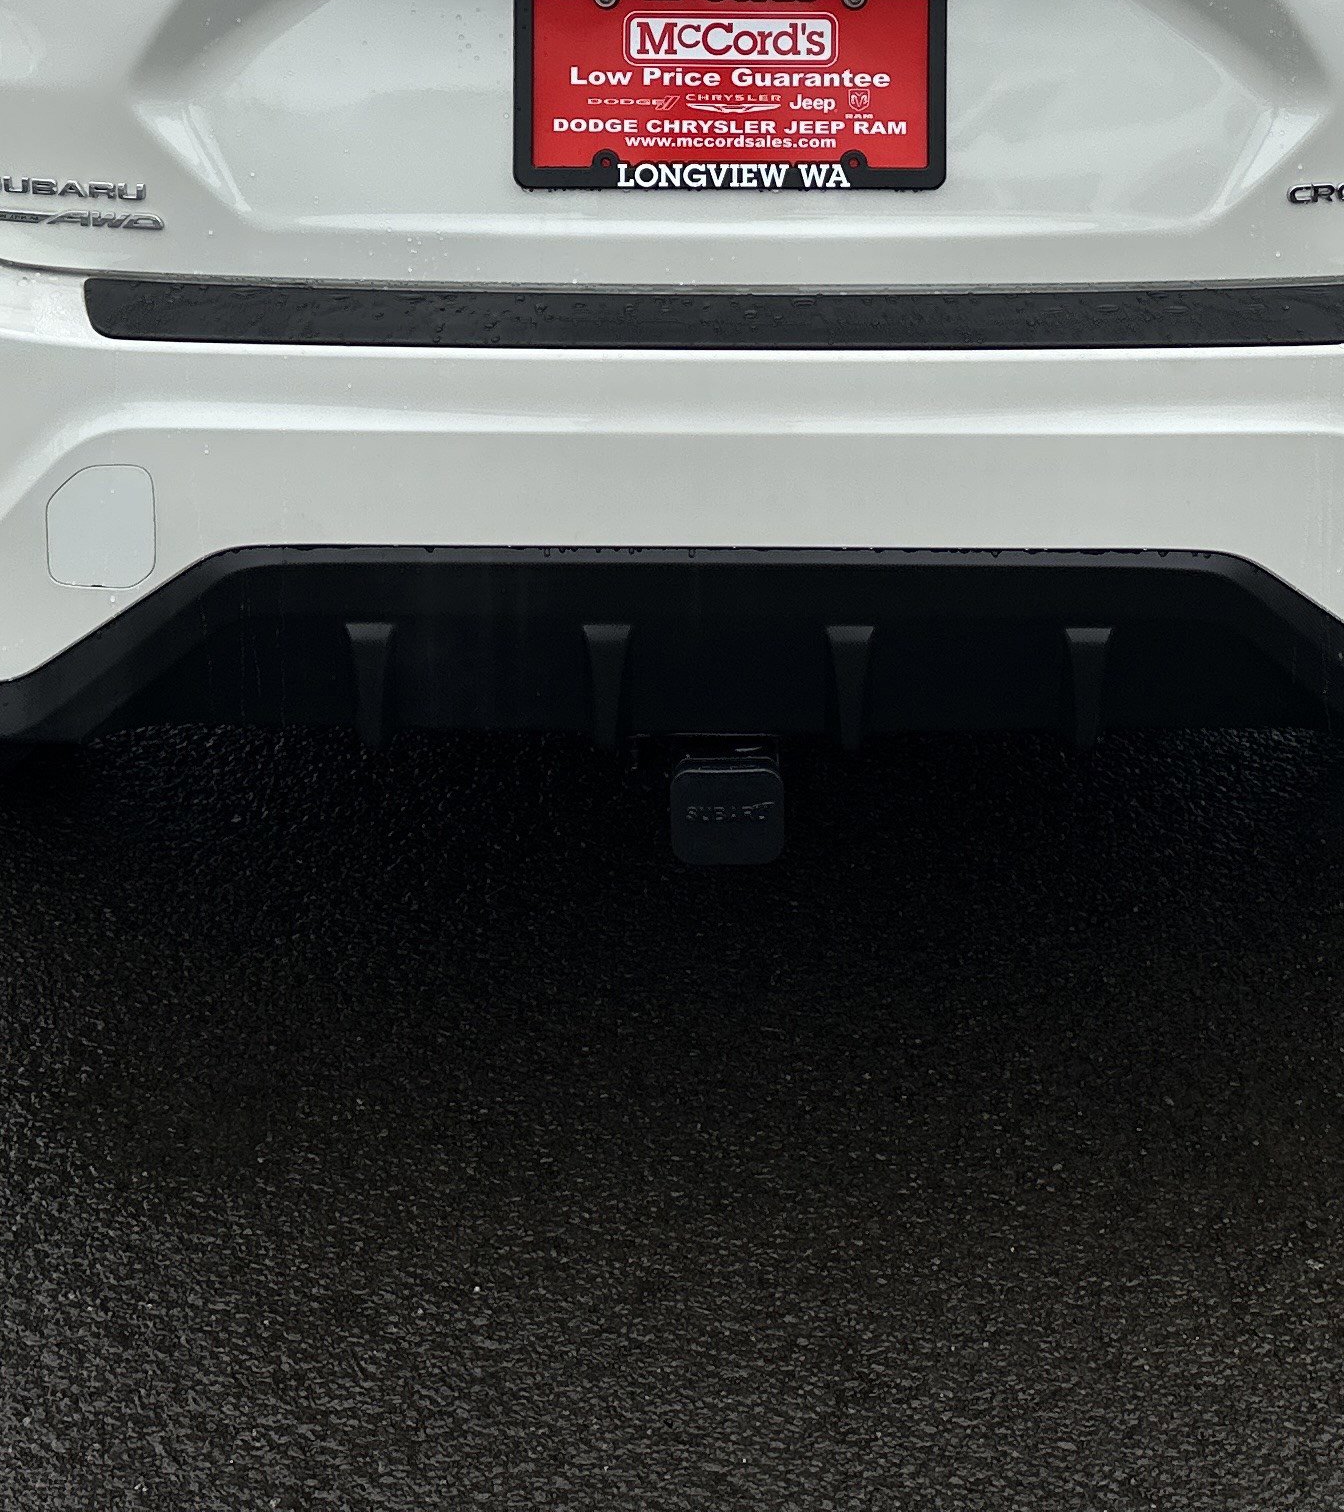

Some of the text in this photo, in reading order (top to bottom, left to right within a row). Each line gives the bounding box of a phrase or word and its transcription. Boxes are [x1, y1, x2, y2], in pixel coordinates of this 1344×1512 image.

[636, 21, 826, 56] McCord's
[569, 66, 891, 88] Low Price Guarantee
[587, 93, 837, 113] DODGE CHRYSLER Jeep
[553, 119, 907, 135] DODGE CHRYSLER JEEP RAM
[624, 134, 837, 148] www.mccordsales.com
[617, 163, 851, 188] LONGVIEW WA
[46, 209, 165, 230] AWD
